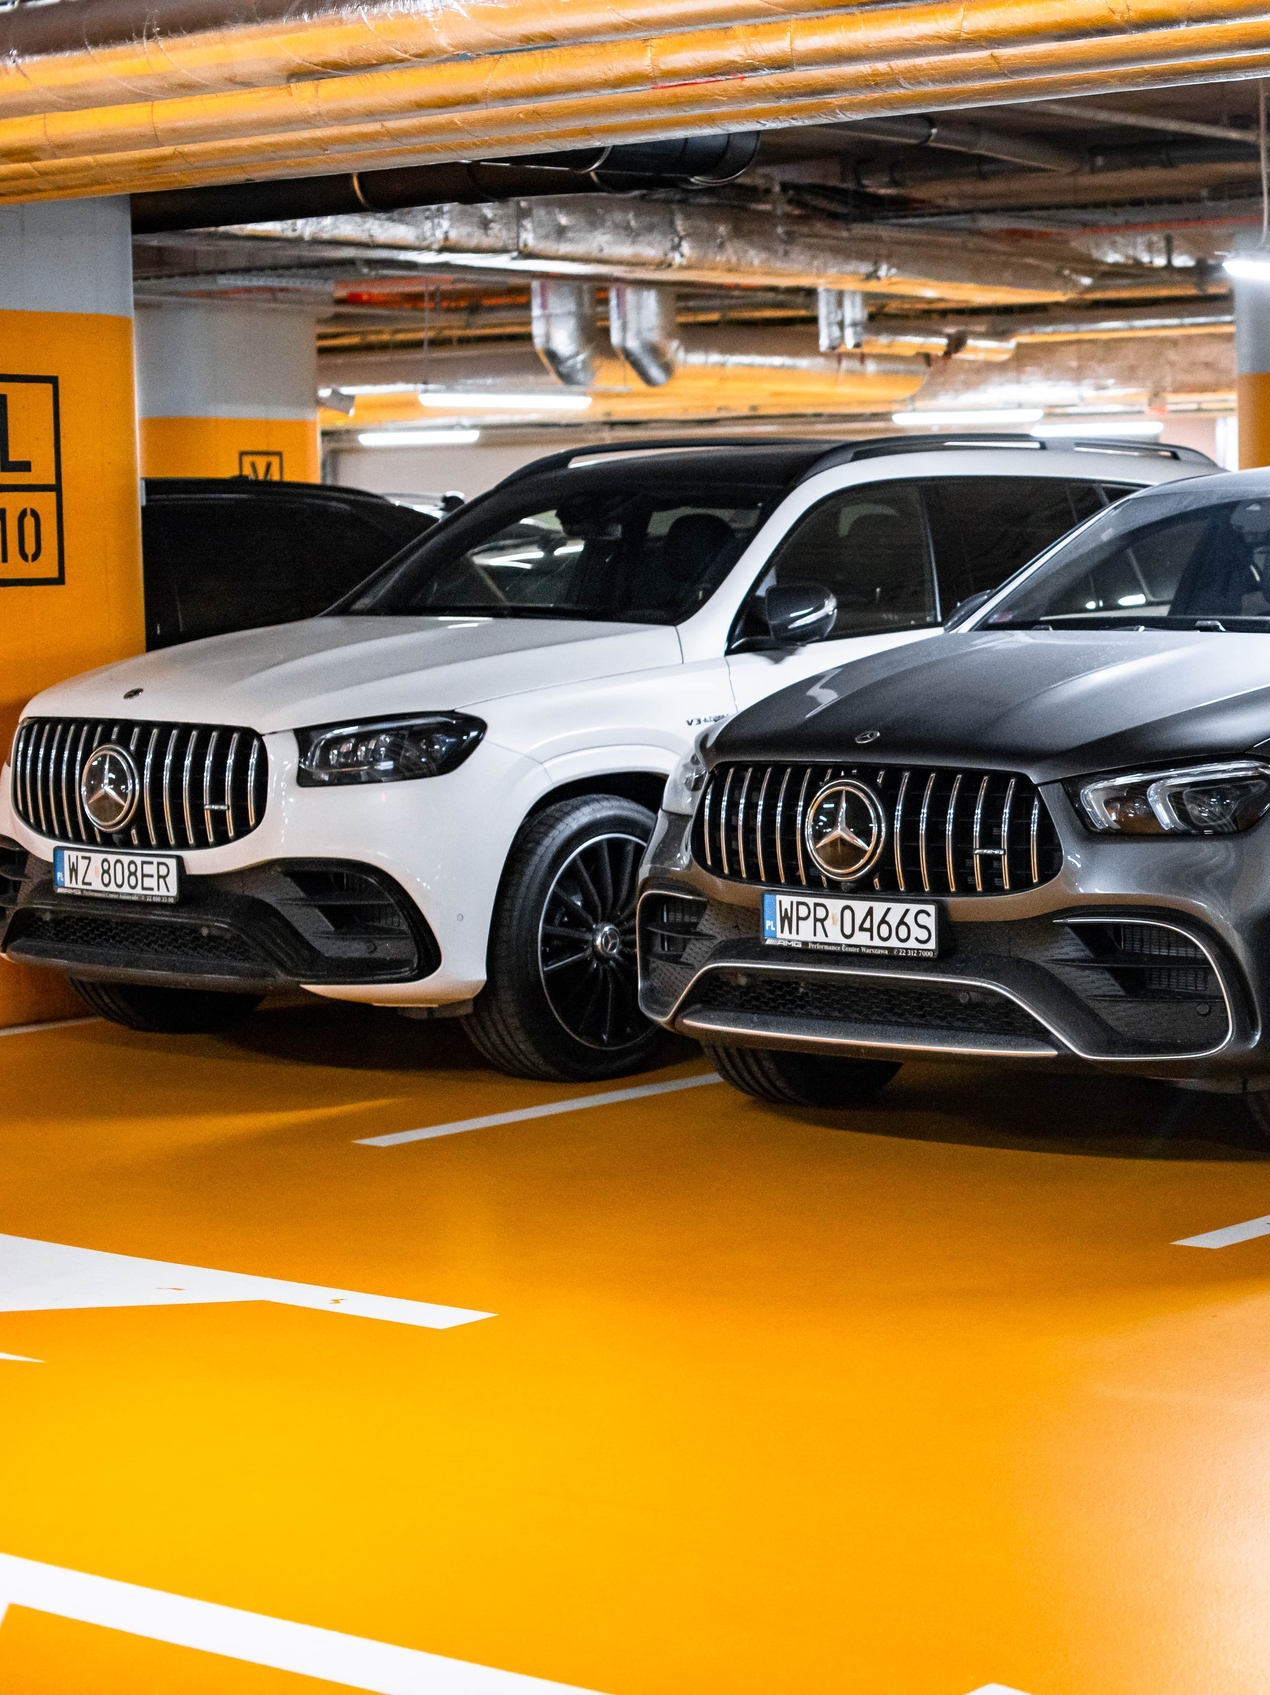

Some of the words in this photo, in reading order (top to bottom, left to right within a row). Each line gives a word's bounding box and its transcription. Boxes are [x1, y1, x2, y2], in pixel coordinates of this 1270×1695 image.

[68, 854, 93, 886] WZ
[100, 857, 170, 893] 808ER
[766, 920, 776, 931] PL
[779, 900, 829, 938] WPR
[840, 904, 932, 945] 0466S
[808, 942, 841, 951] Performance
[841, 944, 860, 952] Center
[861, 946, 889, 955] Warszawa
